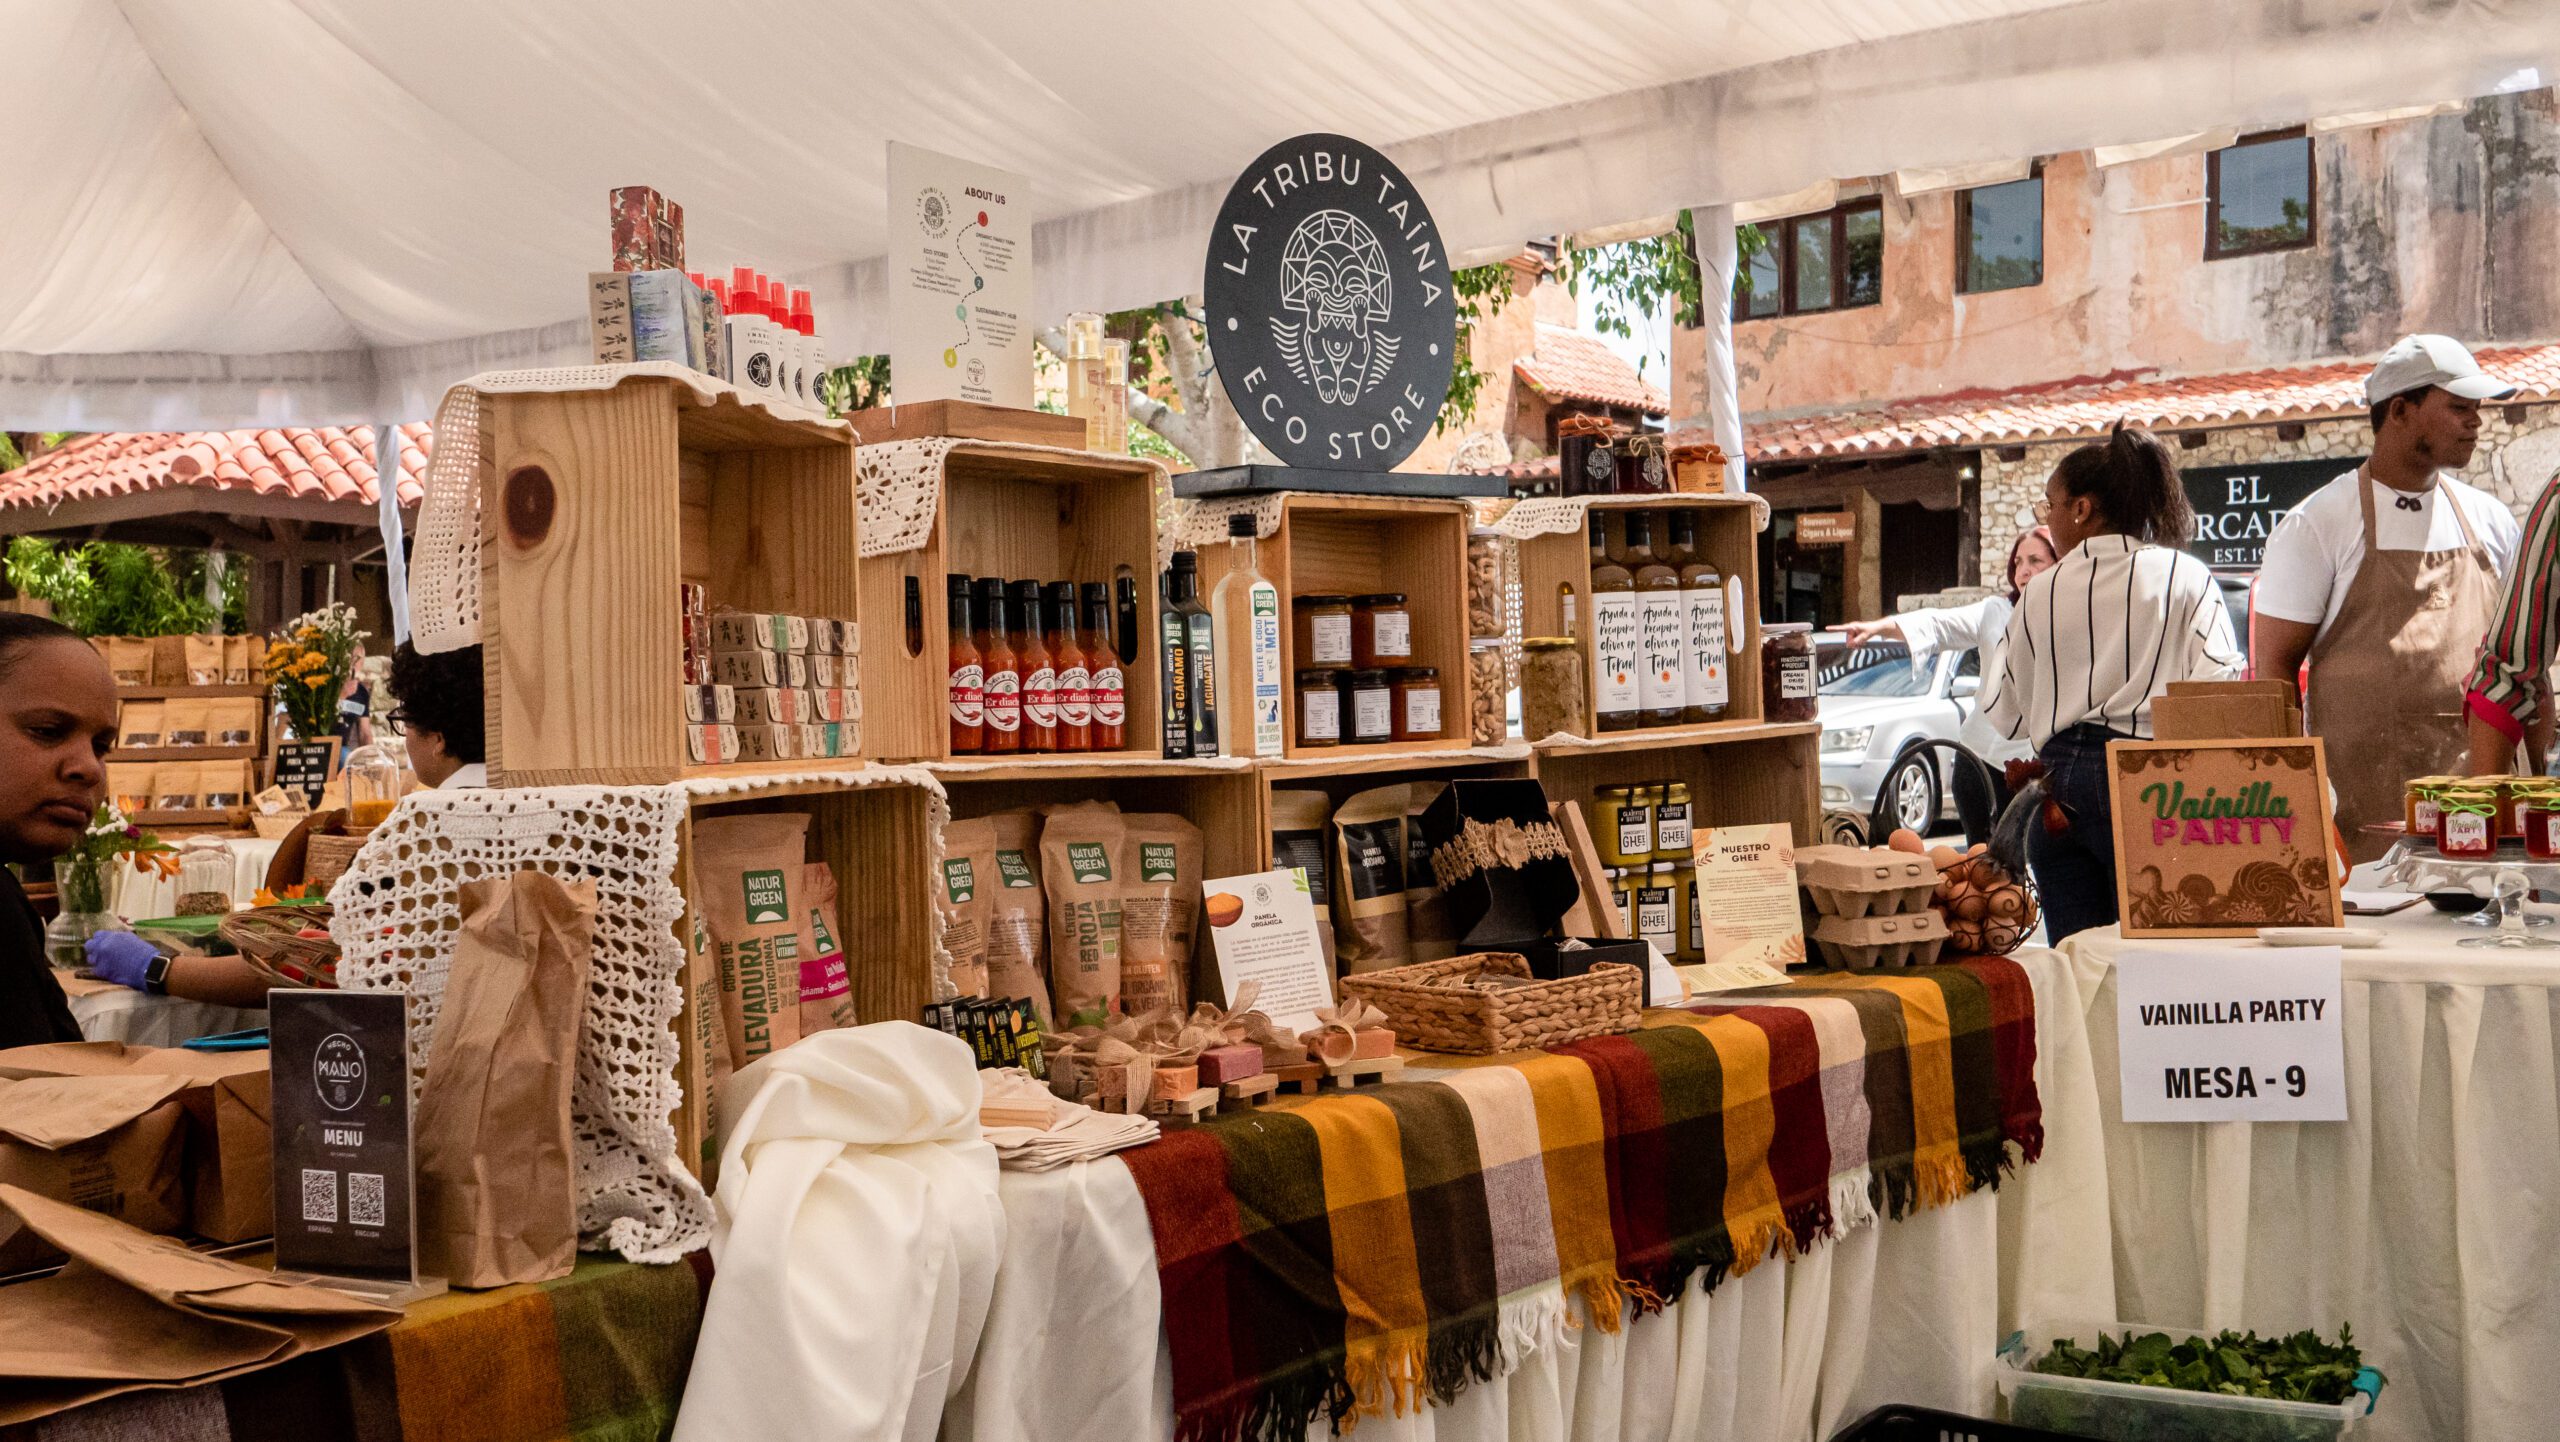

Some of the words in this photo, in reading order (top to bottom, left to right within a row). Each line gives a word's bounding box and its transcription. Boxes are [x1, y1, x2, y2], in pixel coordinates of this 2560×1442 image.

[965, 187, 992, 201] ABOUT
[995, 194, 1005, 205] US
[1223, 223, 1257, 275] LA
[1252, 152, 1360, 208] TRIBU
[1378, 174, 1442, 307] TAÍNA
[1243, 366, 1307, 444] ECO
[1329, 384, 1425, 459] STORE
[2226, 476, 2270, 505] EL
[1803, 517, 1835, 526] Souvenirs
[1803, 529, 1824, 539] Cigars
[2215, 548, 2247, 563] EST.
[1255, 592, 1274, 600] NATUR
[1255, 600, 1274, 608] GREEN
[1599, 606, 1628, 625] Ayuda
[1643, 605, 1671, 624] Ayuda
[1691, 603, 1717, 621] Ayuda
[1265, 620, 1276, 649] MCT
[1600, 624, 1635, 639] recuperar
[1645, 623, 1679, 637] recuperar
[1693, 620, 1723, 635] recuperar
[1257, 638, 1263, 653] DE
[1601, 636, 1624, 653] olivos
[1645, 635, 1668, 652] olivos
[1693, 632, 1714, 648] olivos
[1601, 651, 1635, 677] Teruel
[1646, 650, 1680, 675] Teruel
[1694, 646, 1725, 672] Teruel
[1203, 653, 1214, 705] AGUACATE
[951, 692, 962, 700] Er
[985, 698, 997, 706] Er
[1027, 694, 1039, 703] Er
[1057, 694, 1067, 702] Er
[1091, 694, 1101, 702] Er
[2140, 781, 2294, 821] Vainilla
[1623, 809, 1644, 817] CLARIFIED
[1661, 805, 1684, 813] CLARIFIED
[2152, 816, 2297, 846] PARTY
[2449, 819, 2482, 829] Vainilla
[1622, 834, 1646, 848] GHEE
[1661, 830, 1685, 843] GHEE
[1071, 847, 1101, 858] NATUR
[1145, 847, 1174, 858] NATUR
[1721, 843, 1770, 854] NUESTRO
[997, 854, 1023, 865] NATUR
[1073, 858, 1106, 870] GREEN
[1145, 858, 1175, 869] GREEN
[1731, 854, 1759, 862] GHEE
[948, 863, 970, 875] NATUR
[1003, 865, 1029, 876] GREEN
[748, 876, 780, 890] NATUR
[950, 875, 972, 889] GREEN
[750, 891, 783, 906] GREEN
[1065, 902, 1076, 937] LENTEJA
[1078, 902, 1098, 946] ROJA
[1254, 913, 1277, 921] PANELA
[1641, 915, 1666, 927] GHEE
[720, 940, 733, 955] DE
[1080, 948, 1099, 963] RED
[722, 956, 736, 993] COPOS
[763, 937, 779, 1013] NUTRICIONAL
[738, 937, 771, 1056] LEVADURA
[2140, 1001, 2244, 1027] VAINILLA
[2249, 998, 2326, 1023] PARTY
[327, 1040, 351, 1050] HECHO
[319, 1060, 361, 1078] MANO
[2164, 1065, 2258, 1099] MESA
[2286, 1065, 2306, 1098] 9
[324, 1129, 362, 1147] MENU
[355, 1229, 380, 1238] ENGLISH
